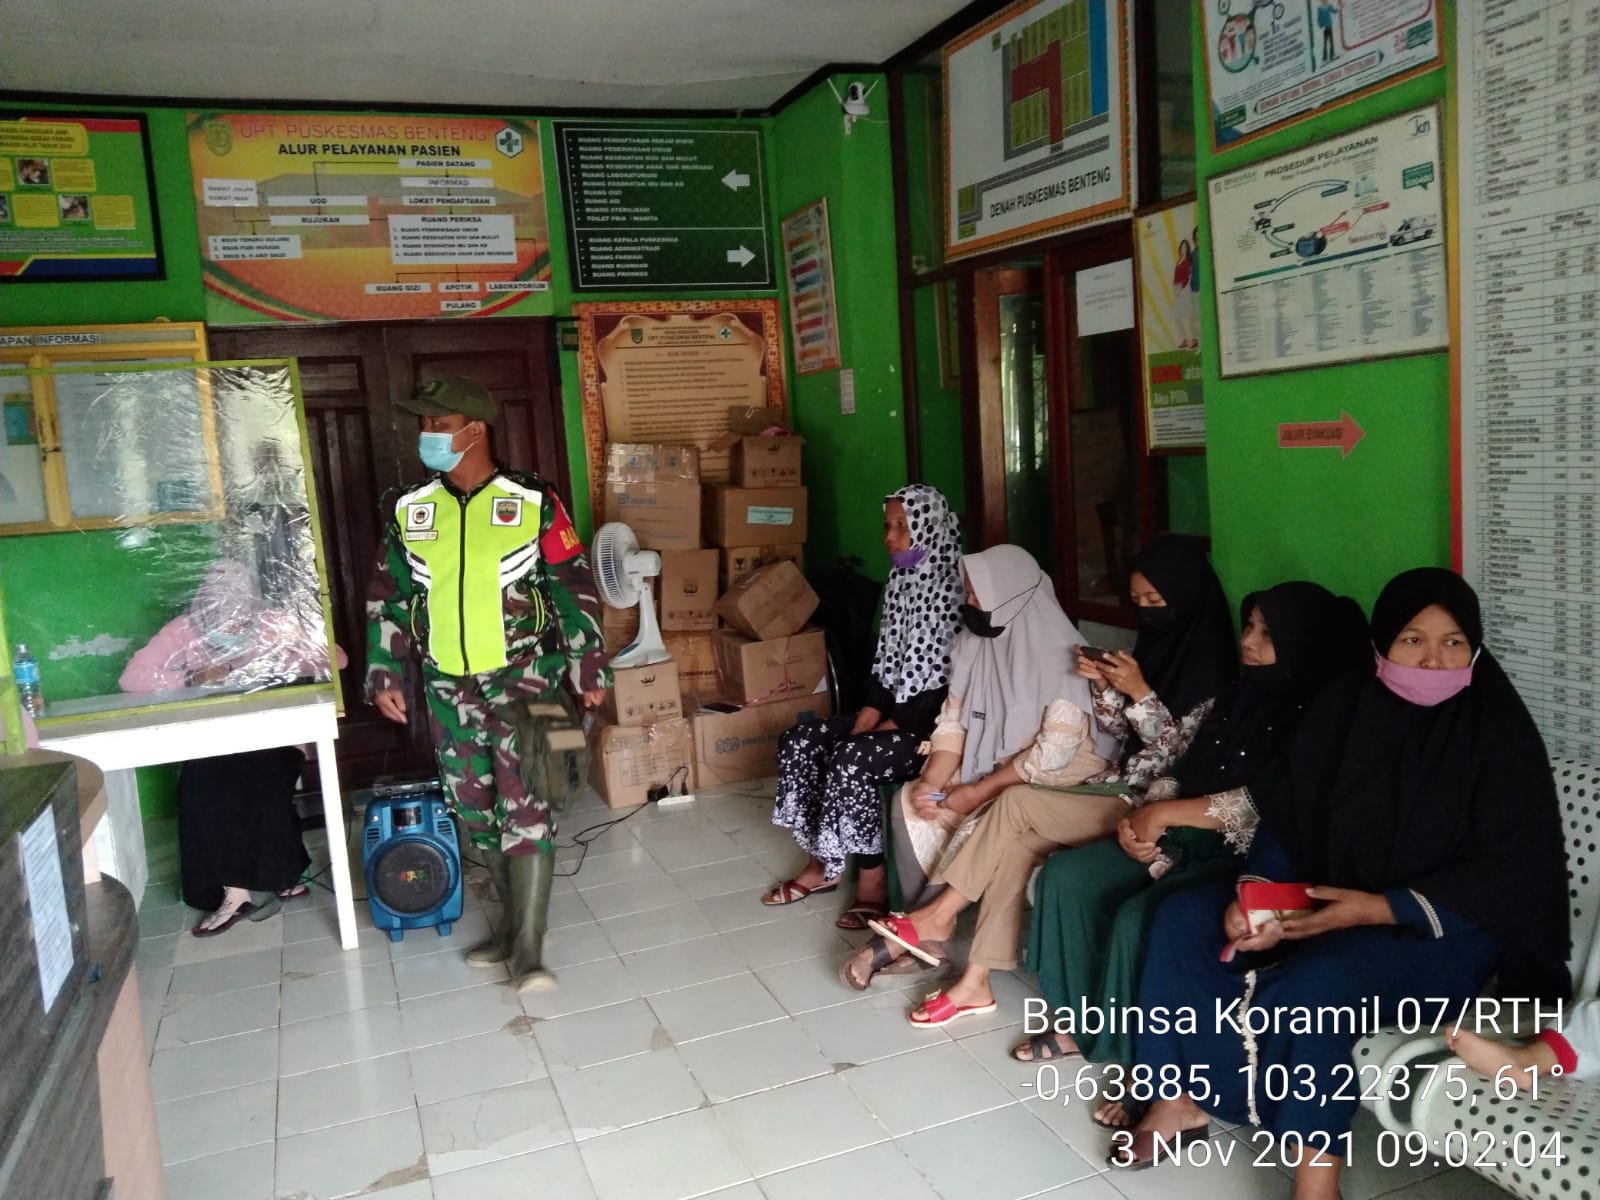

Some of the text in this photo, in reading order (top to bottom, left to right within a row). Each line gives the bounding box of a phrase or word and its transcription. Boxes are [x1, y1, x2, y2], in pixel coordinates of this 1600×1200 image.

[241, 124, 488, 142] UPT PUSKESMAS BENTENG
[278, 144, 461, 157] ALUR PELAYANAN PASIEN
[1264, 135, 1378, 178] PROSEDUR PELAYANAN
[990, 166, 1111, 218] DENAH PUSKESMAS BENTENG
[38, 334, 100, 344] INFORMASI
